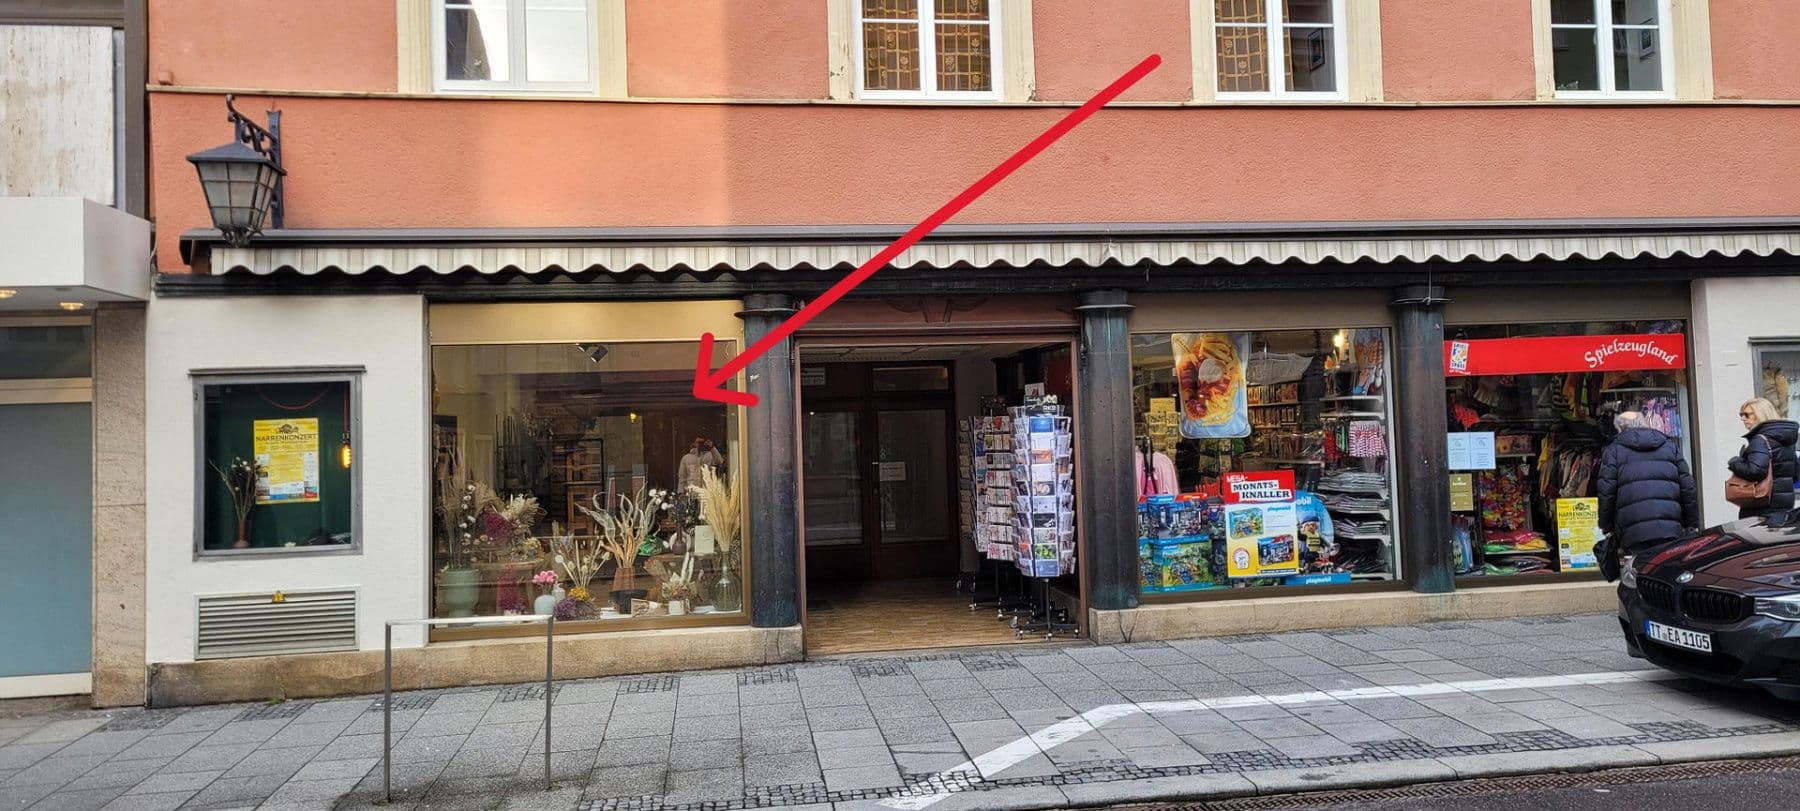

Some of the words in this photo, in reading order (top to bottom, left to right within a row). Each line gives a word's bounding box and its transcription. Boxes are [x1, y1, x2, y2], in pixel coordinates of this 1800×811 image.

[1584, 338, 1678, 368] Spielzeugland
[255, 433, 317, 442] NARRENKONZERT
[1227, 474, 1248, 482] MEGA-
[1233, 481, 1278, 491] MONATS-
[1242, 490, 1290, 499] KNALLER
[1296, 496, 1312, 505] obil
[1650, 623, 1661, 639] TT
[1667, 627, 1681, 644] EA
[1682, 631, 1710, 650] 1105
